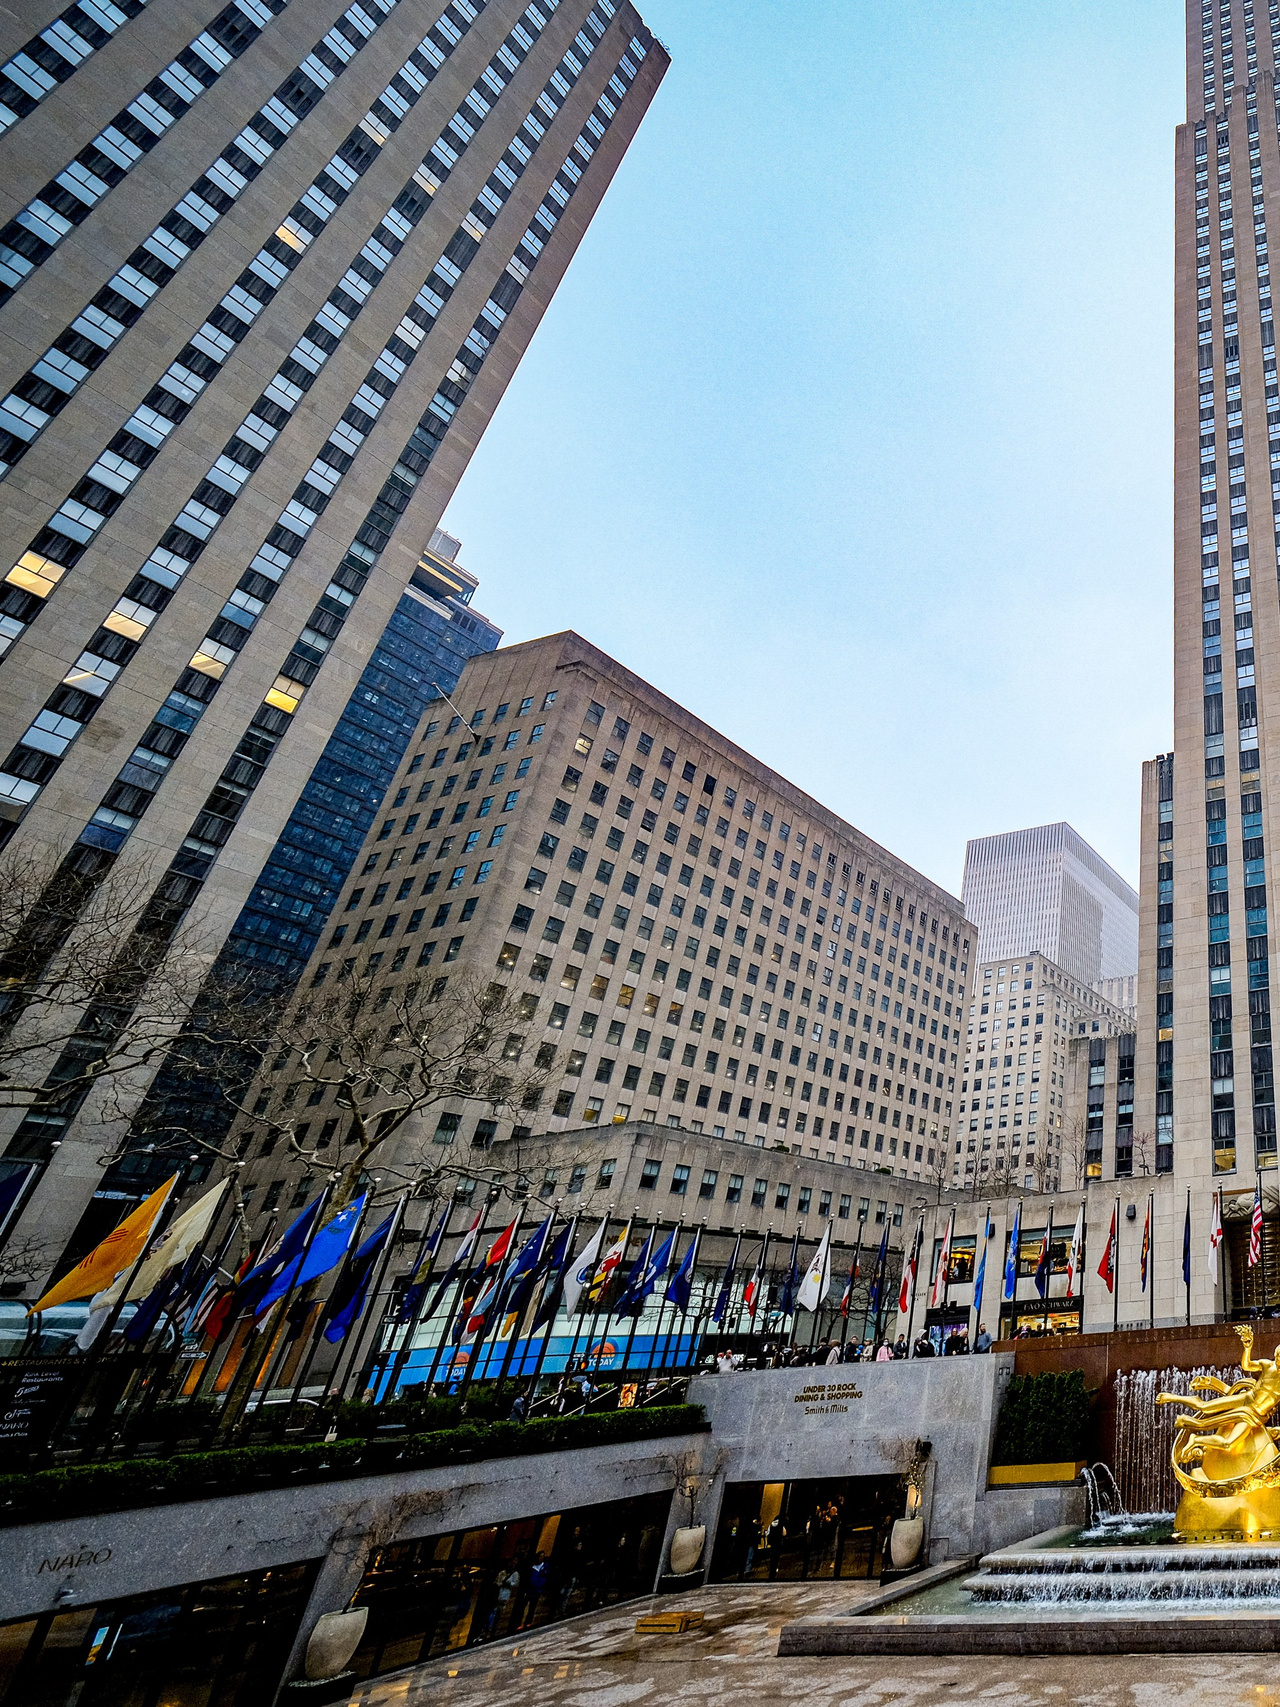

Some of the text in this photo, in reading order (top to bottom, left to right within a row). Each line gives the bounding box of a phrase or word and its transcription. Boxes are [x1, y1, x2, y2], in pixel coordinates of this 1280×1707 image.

[588, 1358, 615, 1367] TODAY
[803, 1382, 857, 1393] UNDER 30 ROCK
[794, 1391, 863, 1403] DINING & SHOPPING
[804, 1405, 825, 1415] Smith
[830, 1404, 849, 1413] Mills
[37, 1548, 112, 1575] NARO
